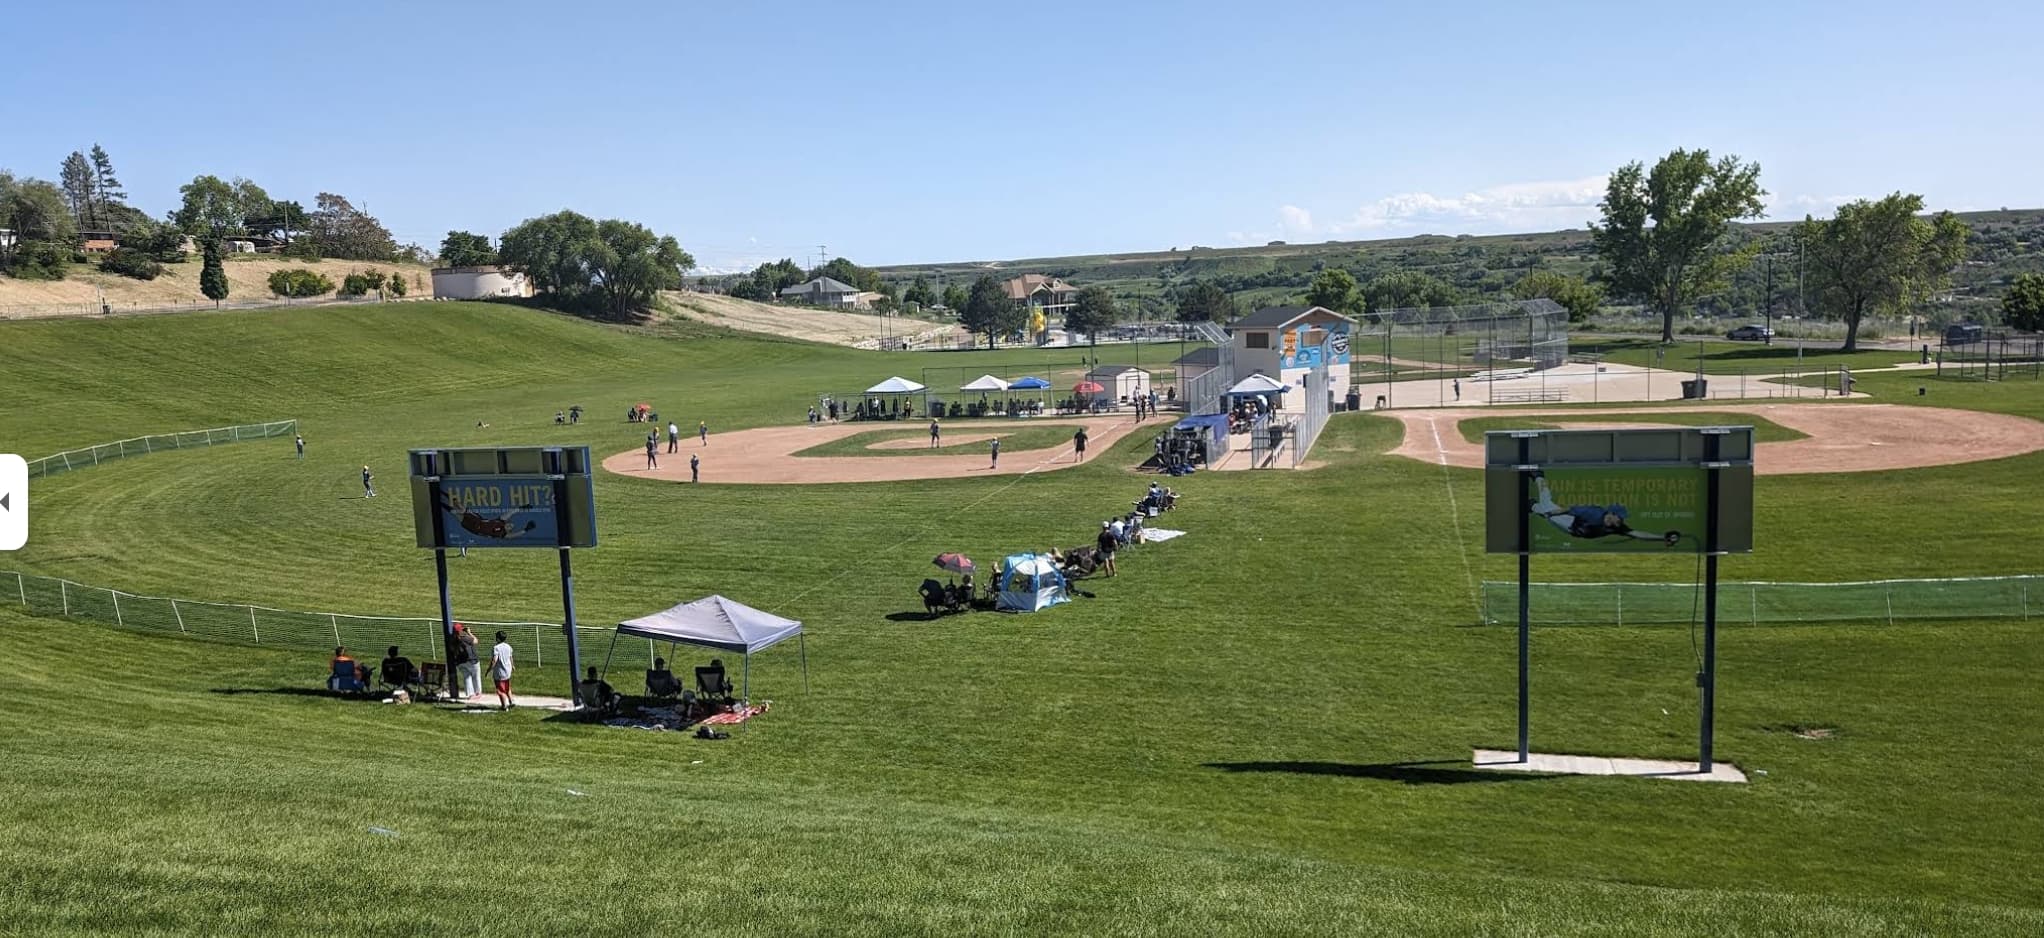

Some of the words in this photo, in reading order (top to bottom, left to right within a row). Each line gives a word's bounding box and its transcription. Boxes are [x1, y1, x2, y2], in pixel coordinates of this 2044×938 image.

[1581, 479, 1595, 492] IS
[1603, 479, 1698, 492] TEMPORARY
[448, 487, 501, 507] HARD
[509, 485, 552, 506] HIT?
[1557, 493, 1639, 507] ADDICTION
[1646, 493, 1659, 507] IS
[1667, 493, 1697, 506] NOT
